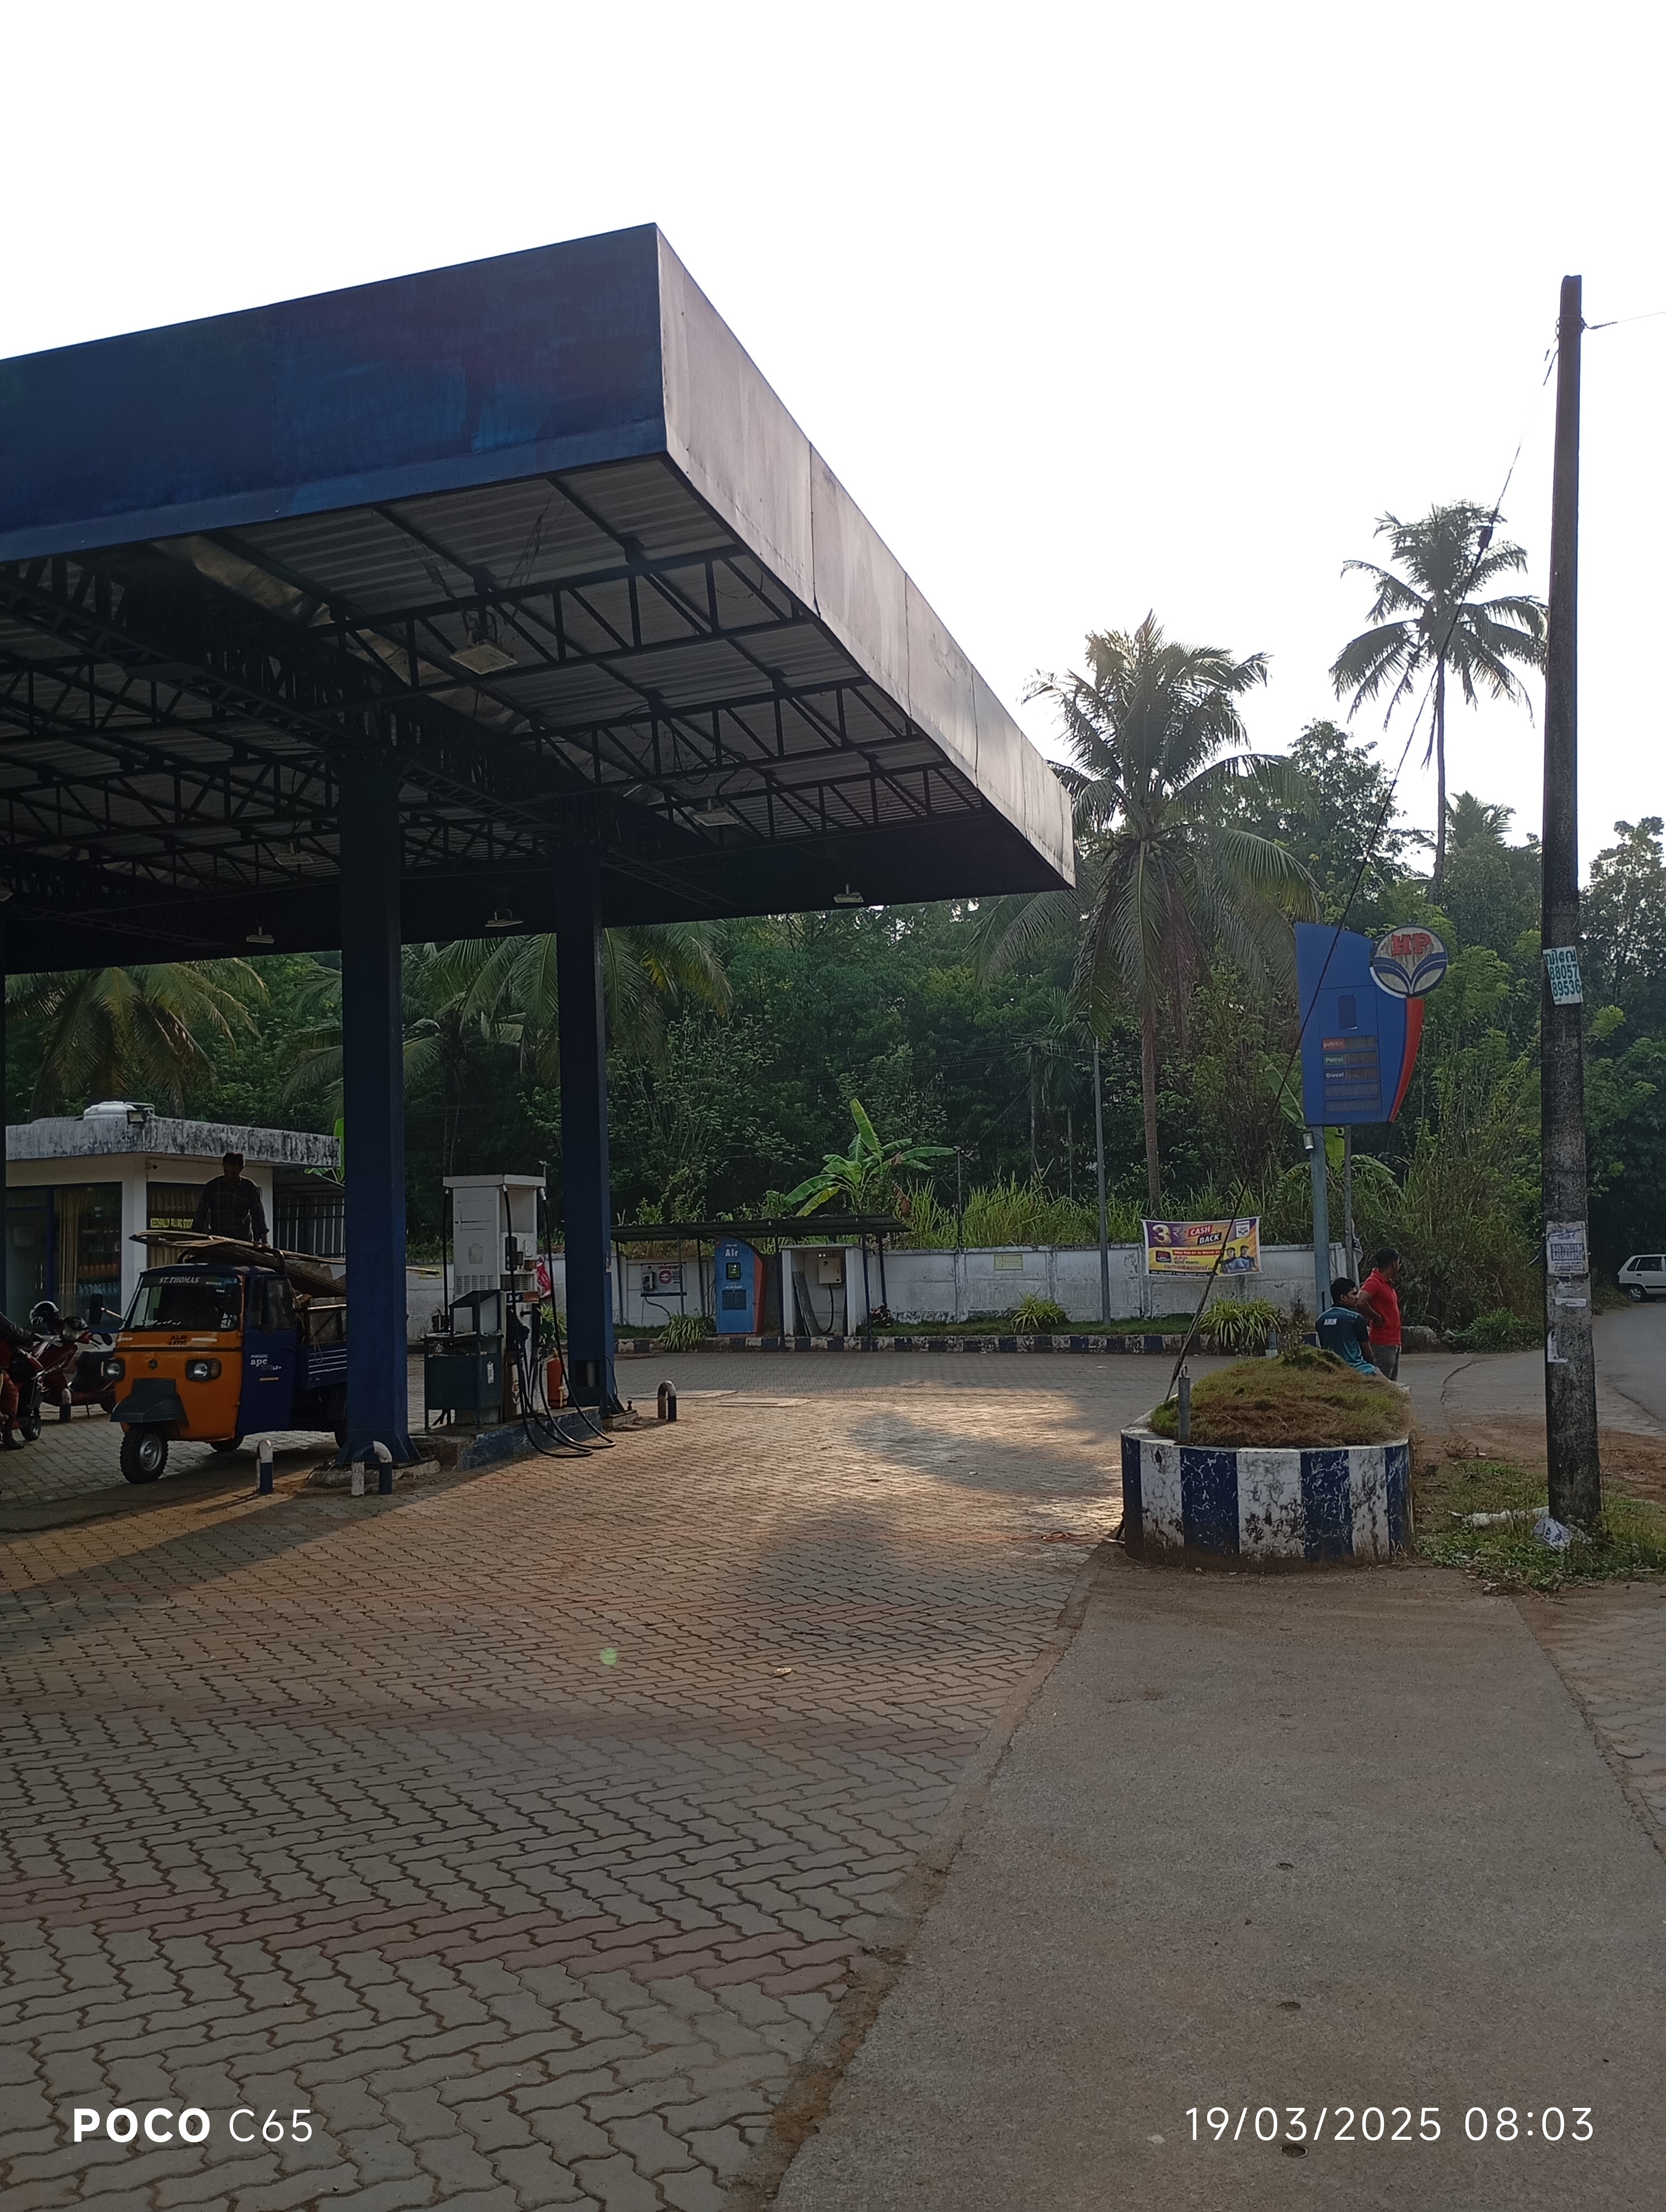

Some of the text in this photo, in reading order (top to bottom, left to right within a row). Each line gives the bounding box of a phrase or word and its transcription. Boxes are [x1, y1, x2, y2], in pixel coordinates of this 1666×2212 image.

[1392, 933, 1431, 955] HP
[1549, 964, 1577, 981] 88057
[1552, 978, 1581, 996] 89536
[1152, 1224, 1171, 1244] 3
[1190, 1225, 1210, 1235] CASH
[1199, 1233, 1220, 1244] BACK
[725, 1248, 738, 1257] Air
